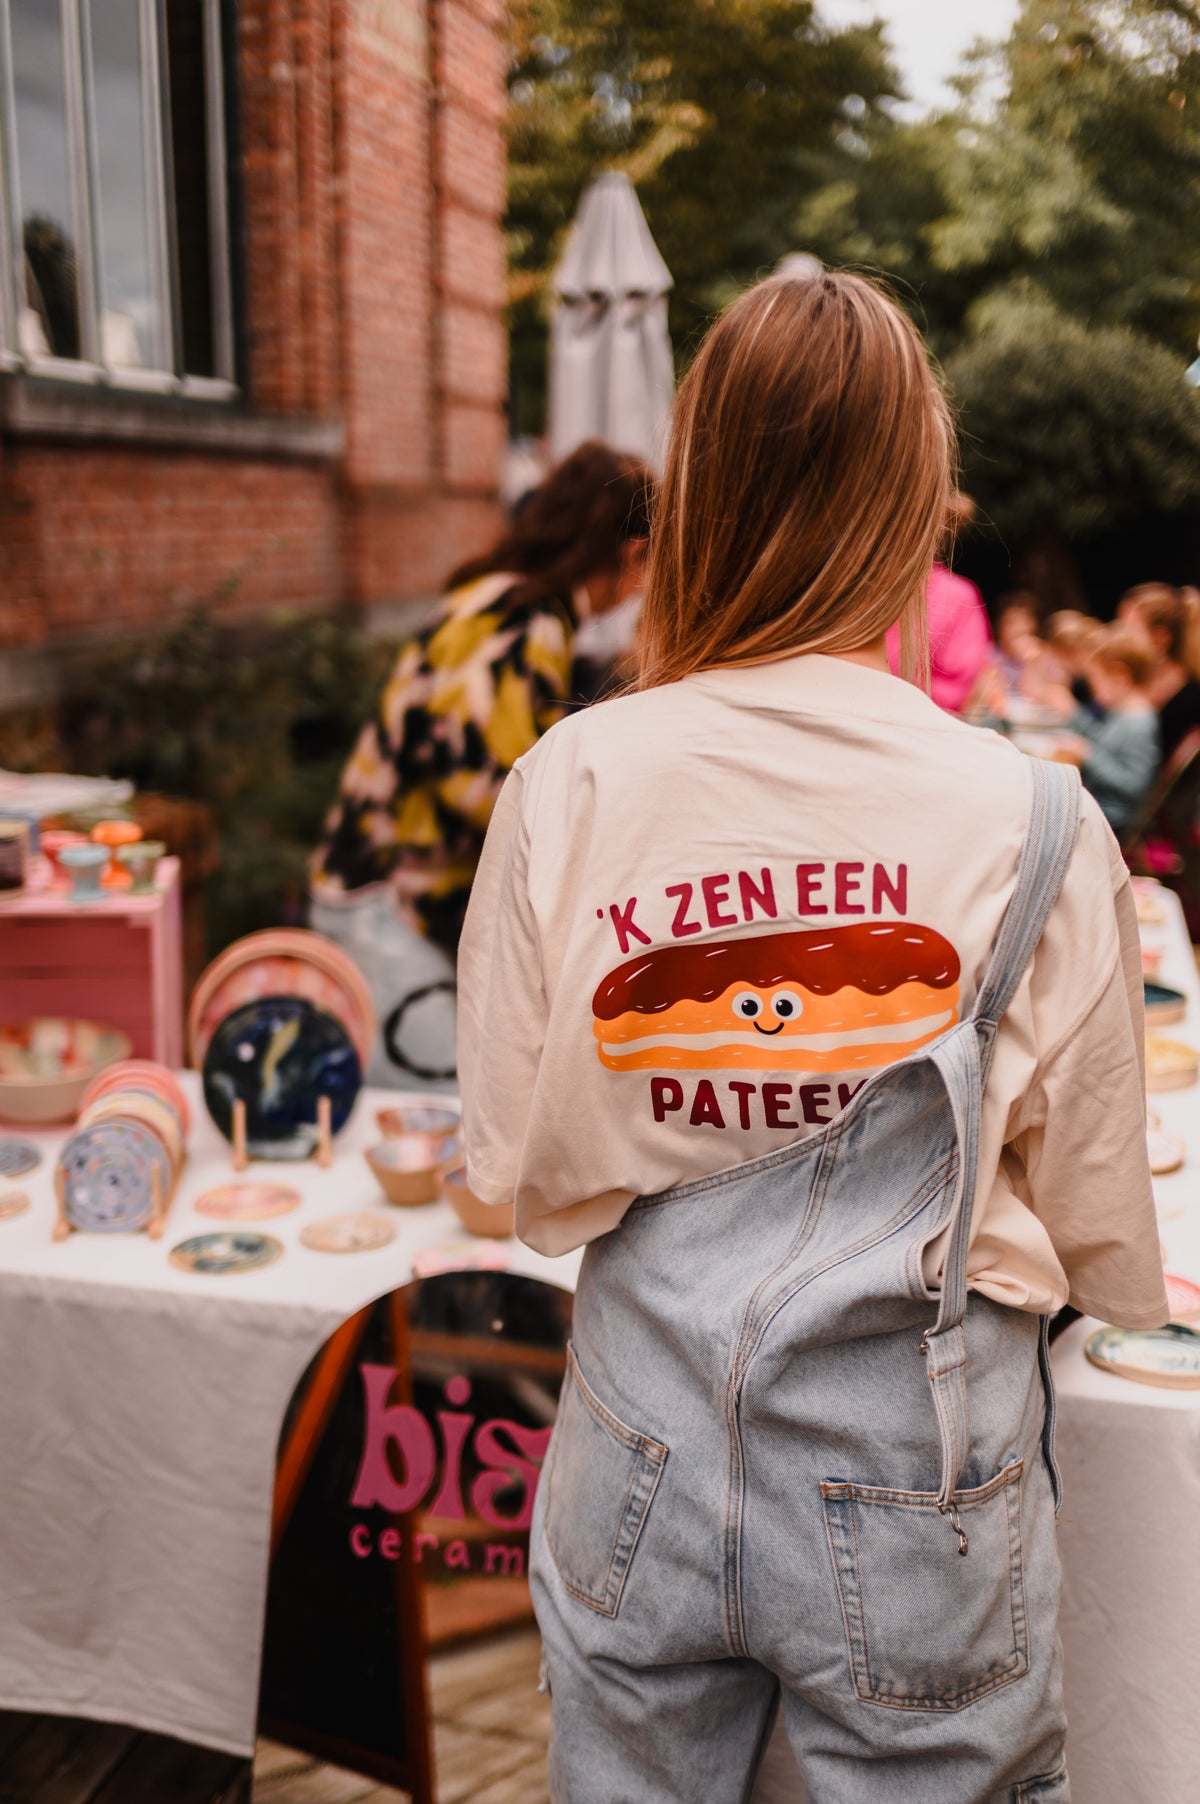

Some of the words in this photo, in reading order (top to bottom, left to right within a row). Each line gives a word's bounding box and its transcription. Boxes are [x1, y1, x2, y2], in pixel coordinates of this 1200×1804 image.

[596, 897, 652, 954] 'K
[665, 867, 778, 938] ZEN
[796, 862, 907, 916] EEN
